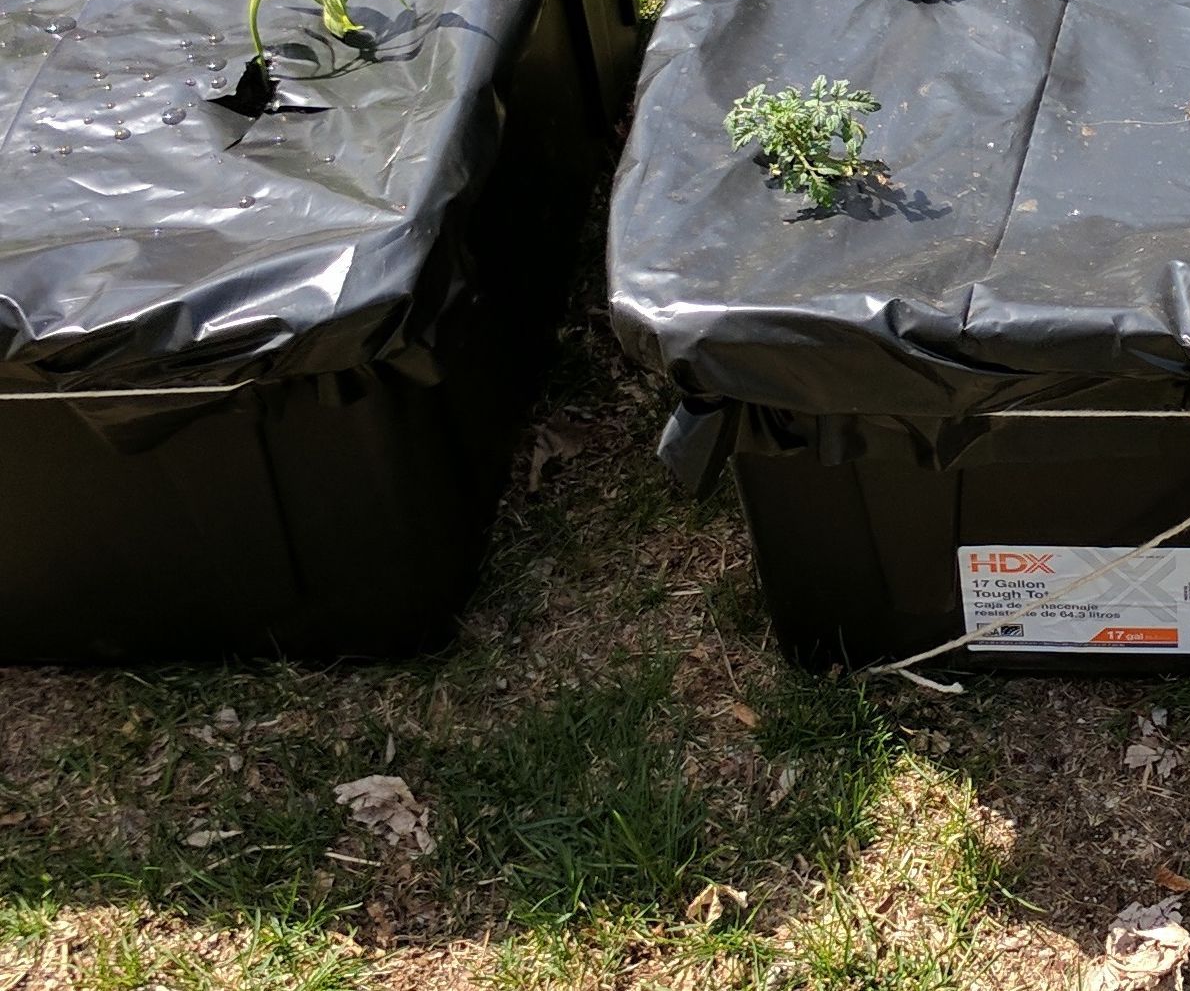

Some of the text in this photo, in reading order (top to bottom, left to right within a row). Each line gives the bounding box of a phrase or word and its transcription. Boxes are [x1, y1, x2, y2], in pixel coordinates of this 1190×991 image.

[971, 553, 1055, 573] HDX
[973, 579, 1045, 589] 17 Gallon
[973, 590, 1021, 601] Tough
[973, 602, 1003, 610] Caja
[1060, 611, 1086, 619] 64.3
[1089, 611, 1121, 619] litros
[1107, 631, 1124, 640] 17
[1125, 633, 1143, 641] gal
